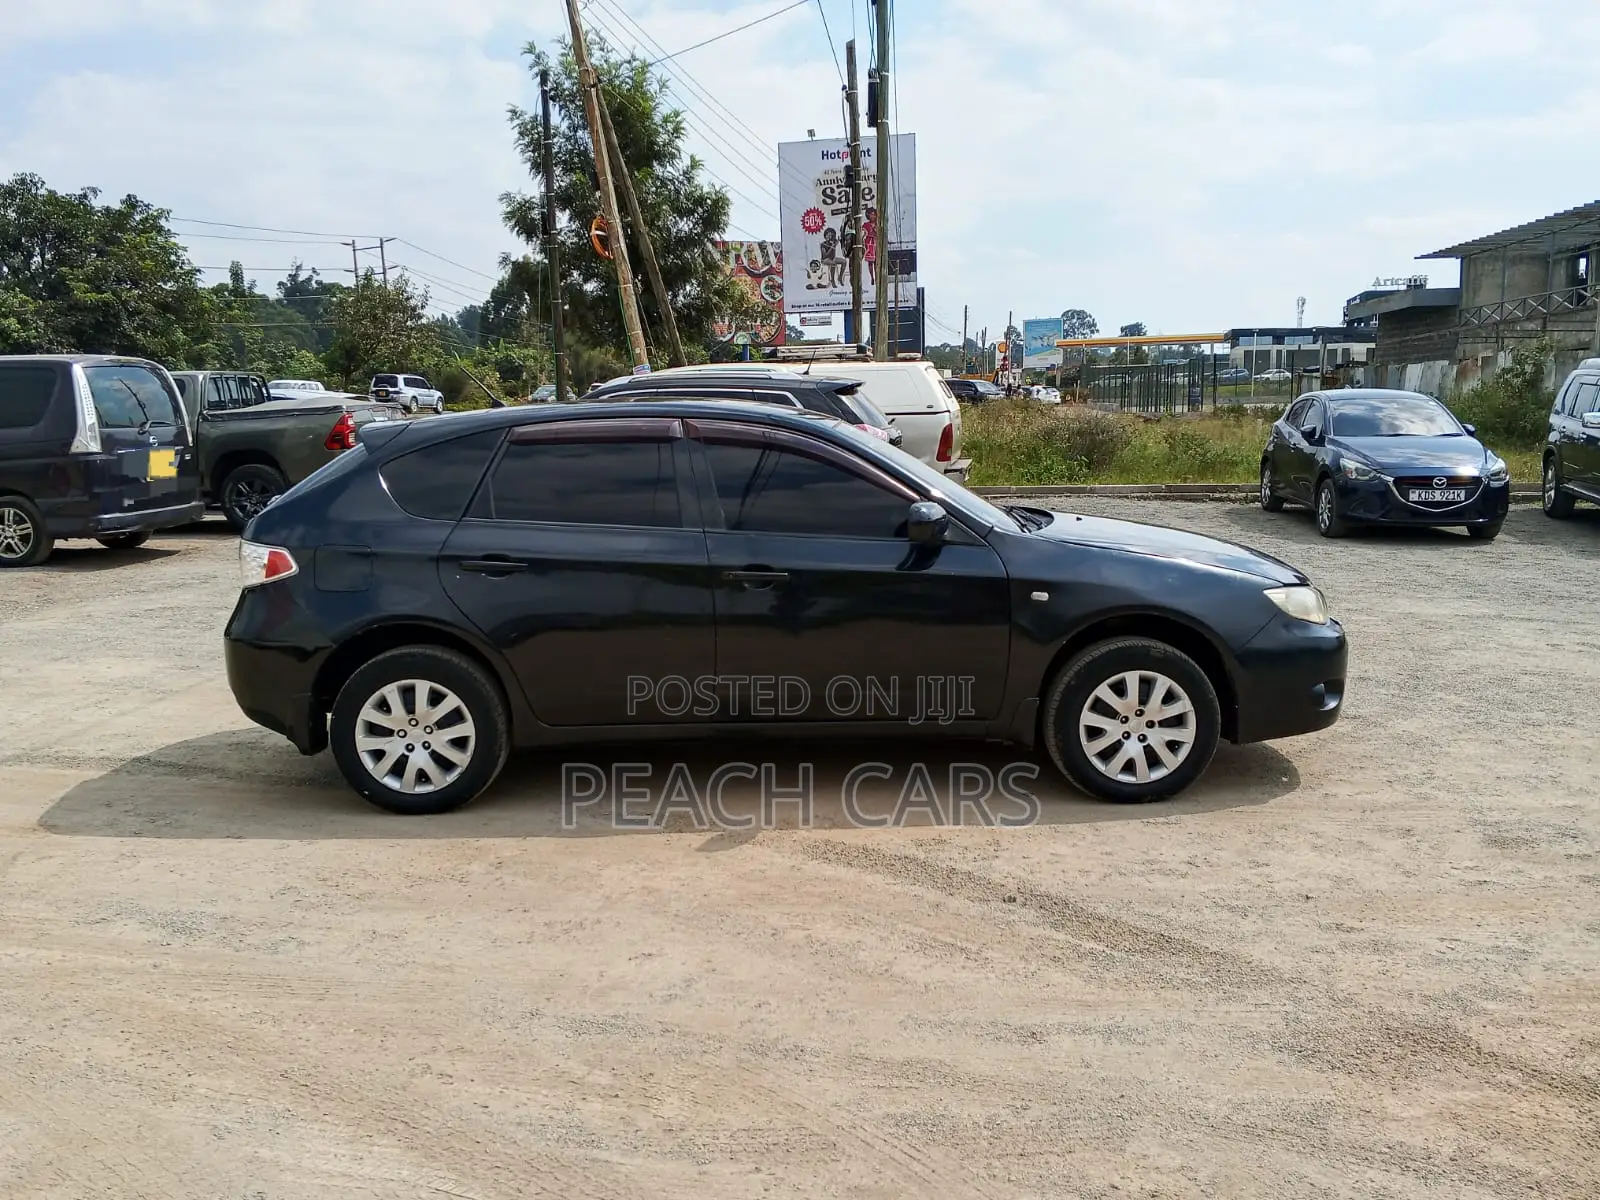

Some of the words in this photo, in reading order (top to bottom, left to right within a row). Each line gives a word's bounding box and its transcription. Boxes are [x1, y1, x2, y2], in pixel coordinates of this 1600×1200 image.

[821, 147, 872, 162] Hotpnt
[816, 174, 877, 187] Annivary
[822, 185, 875, 206] Sae
[804, 215, 823, 227] 50%
[1417, 490, 1436, 501] KDS
[1439, 490, 1462, 501] 921K
